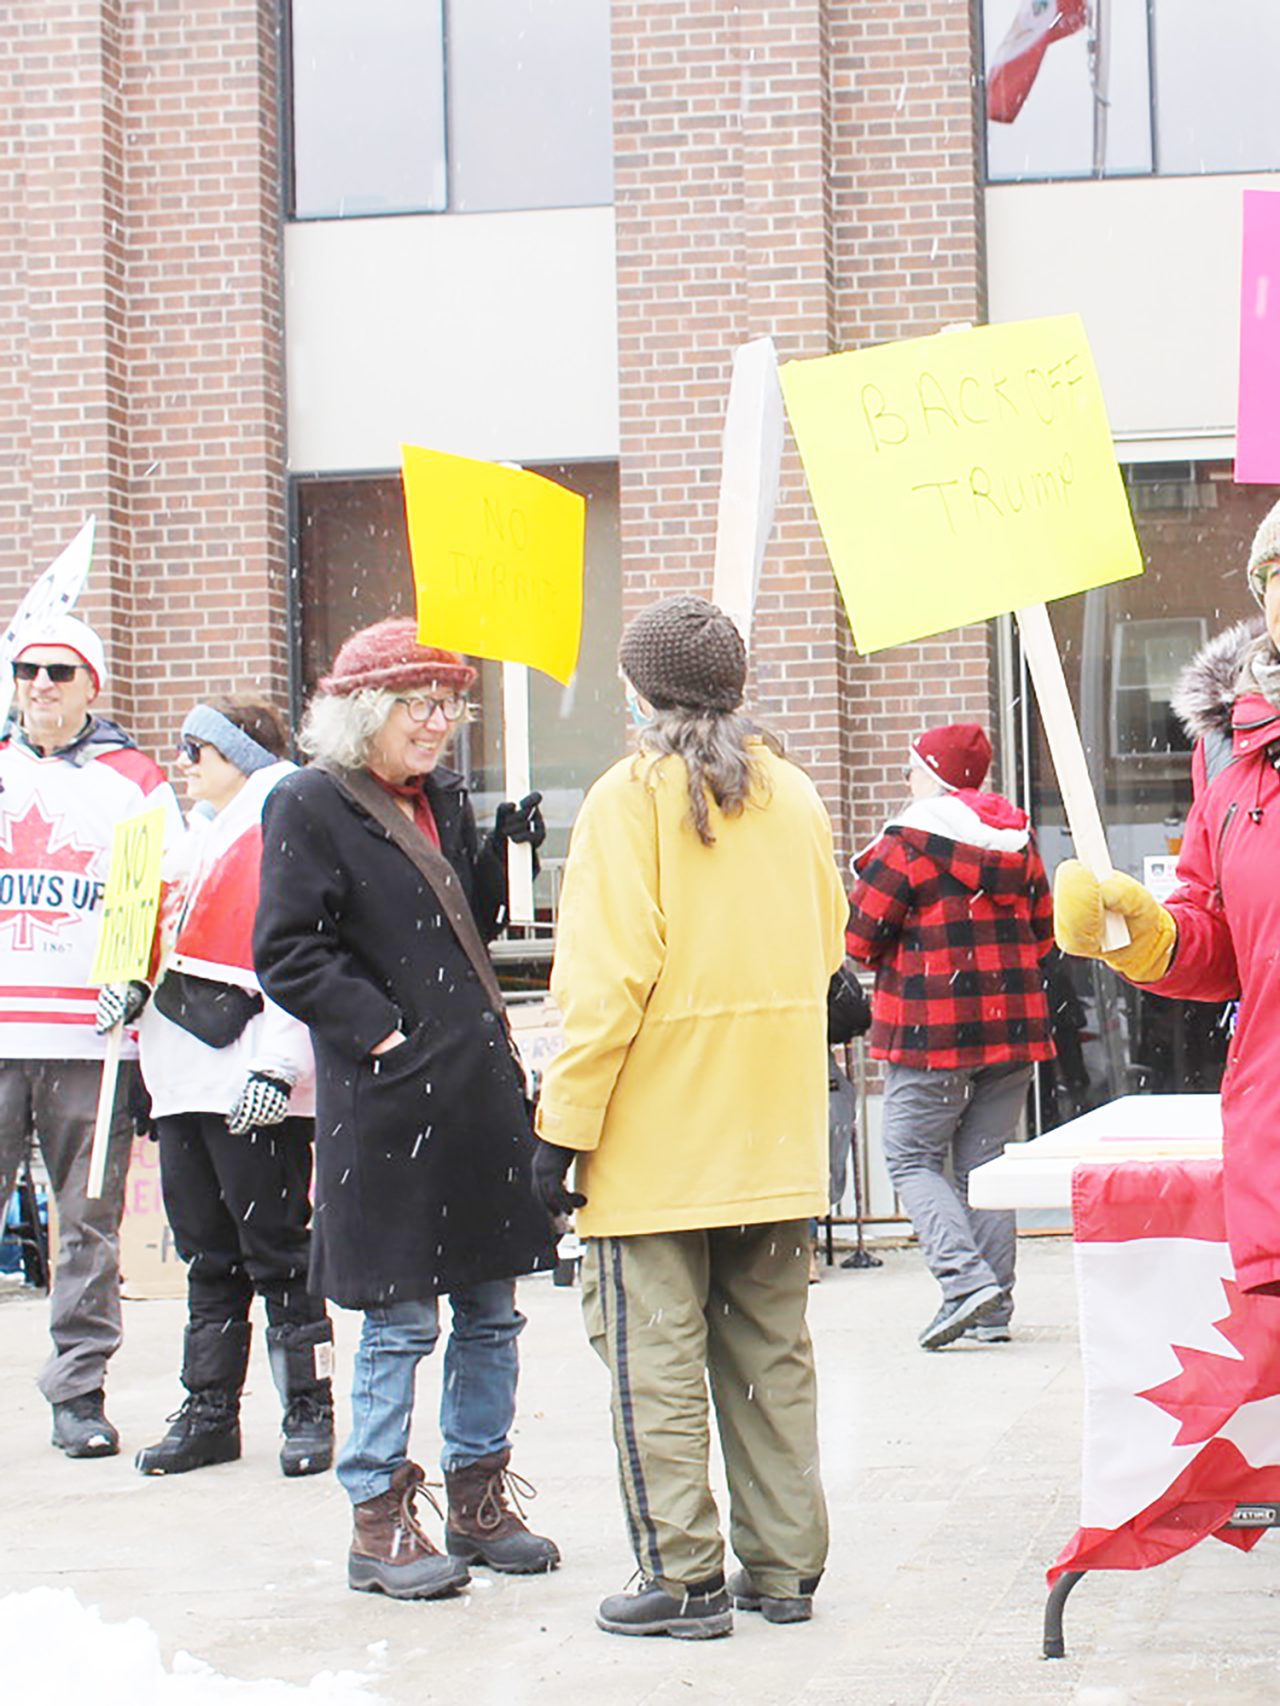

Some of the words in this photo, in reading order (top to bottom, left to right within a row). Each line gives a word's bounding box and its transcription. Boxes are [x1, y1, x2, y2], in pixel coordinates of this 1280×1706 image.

[860, 370, 1021, 453] BACK
[1025, 354, 1086, 426] OFF
[482, 495, 528, 552] NO
[118, 824, 150, 896] NO
[43, 941, 74, 953] 1867
